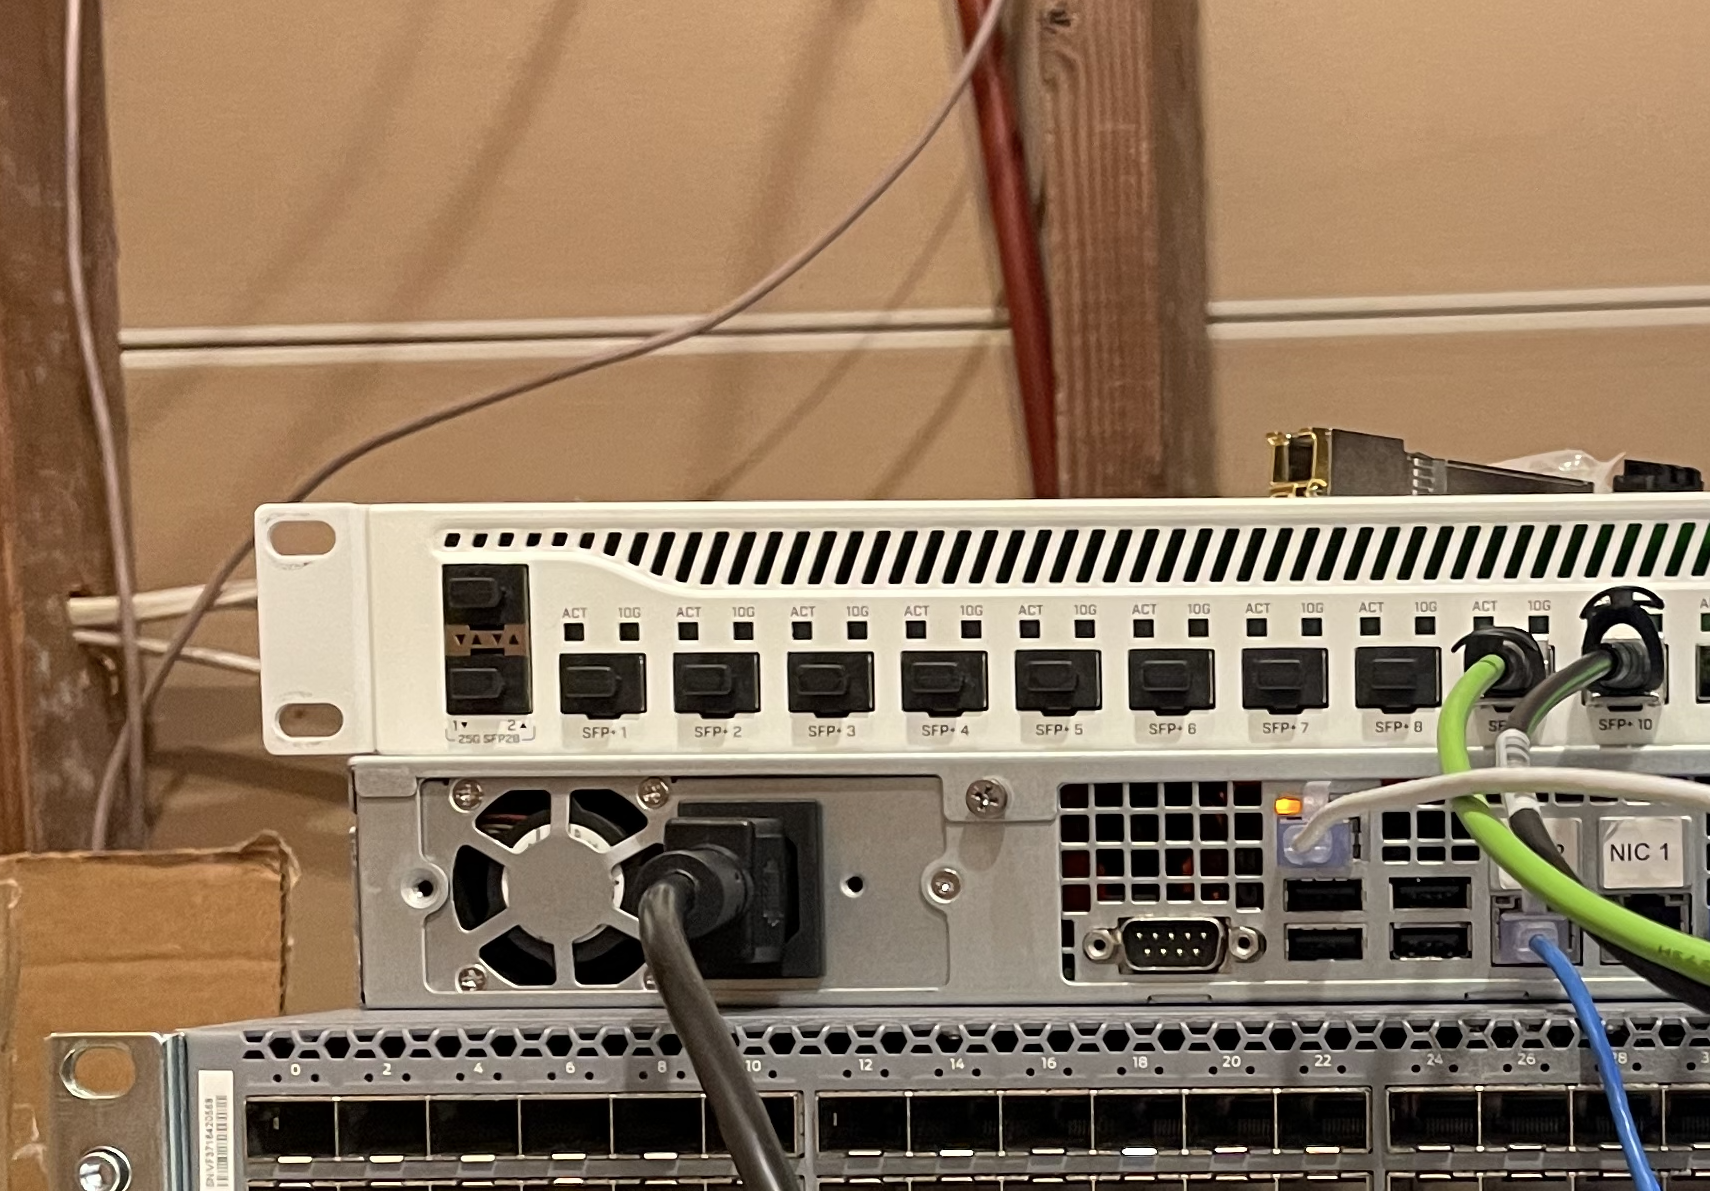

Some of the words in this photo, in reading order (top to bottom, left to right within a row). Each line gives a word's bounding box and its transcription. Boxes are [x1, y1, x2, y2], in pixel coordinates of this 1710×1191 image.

[676, 606, 701, 618] ACT
[732, 606, 755, 618] 10G
[790, 606, 816, 618] ACT
[847, 606, 869, 617] 10G
[904, 605, 929, 617] ACT
[960, 605, 983, 617] 10G
[1018, 604, 1043, 616] ACT
[1074, 604, 1097, 616] 10G
[1132, 603, 1157, 615] ACT
[1188, 603, 1210, 615] 10G
[1246, 602, 1270, 614] ACT
[1301, 602, 1324, 614] 10G
[1359, 602, 1384, 613] ACT
[1415, 601, 1437, 613] 10G
[1472, 600, 1498, 612] ACT
[1528, 600, 1551, 612] 10G
[562, 607, 587, 619] ACT
[618, 607, 641, 619] 10G
[452, 719, 458, 731] 1
[507, 719, 516, 732] 2
[1035, 724, 1070, 736] SFP+
[1074, 723, 1084, 735] 5
[1149, 723, 1183, 735] SFP+
[1187, 723, 1197, 735] 6
[1262, 722, 1297, 734] SFP+
[1300, 722, 1310, 734] 7
[1375, 721, 1410, 733] SFP+
[1413, 721, 1423, 733] 8
[1598, 719, 1634, 730] SFP+
[1637, 718, 1653, 730] 10
[582, 727, 616, 739] SFP+
[620, 727, 627, 739] 1
[694, 726, 728, 738] SFP+
[732, 726, 742, 738] 2
[808, 726, 842, 738] SFP+
[846, 725, 856, 737] 3
[921, 725, 956, 737] SFP+
[960, 724, 970, 736] 4
[1610, 842, 1651, 862] NIC
[1659, 842, 1669, 861] 1
[859, 1059, 873, 1071] 12
[949, 1058, 965, 1070] 14
[1041, 1057, 1057, 1069] 16
[1132, 1056, 1148, 1068] 18
[1223, 1055, 1241, 1068] 20
[1314, 1055, 1332, 1067] 22
[1426, 1053, 1444, 1066] 24
[1518, 1053, 1536, 1066] 26
[291, 1063, 301, 1076] 0
[383, 1063, 392, 1075] 2
[473, 1062, 484, 1074] 4
[566, 1061, 576, 1074] 6
[658, 1061, 667, 1073] 8
[745, 1060, 762, 1072] 10
